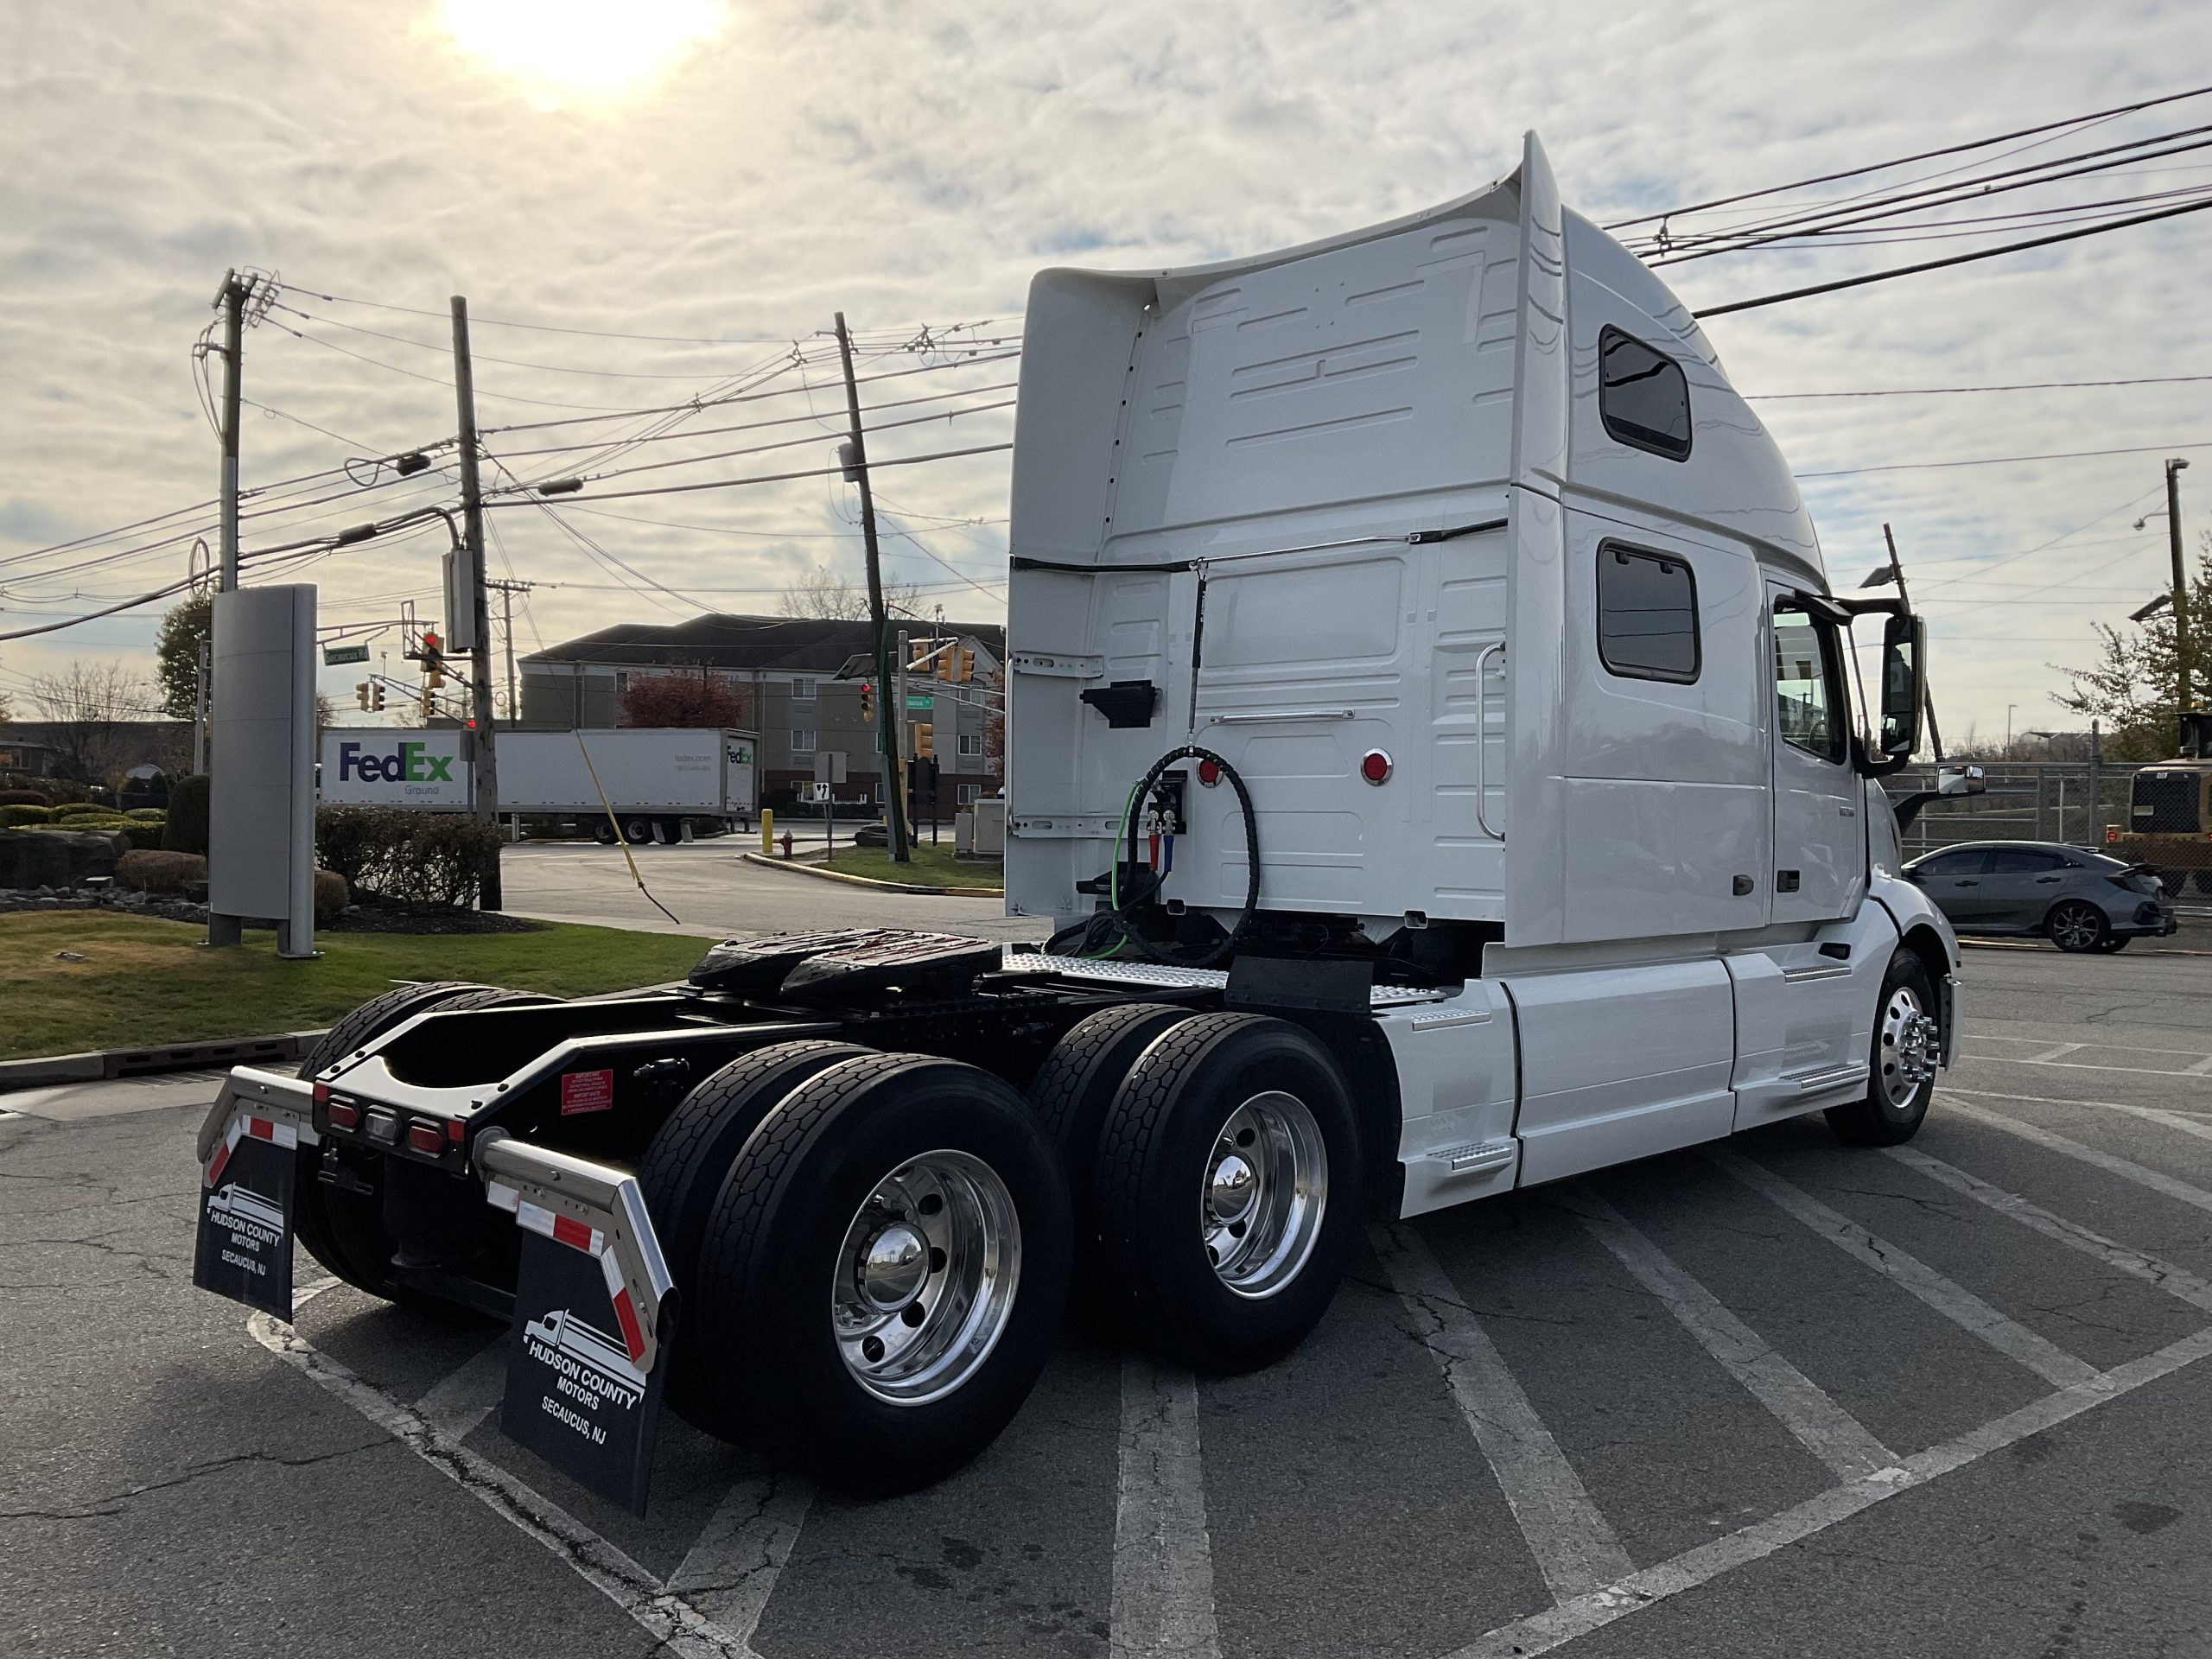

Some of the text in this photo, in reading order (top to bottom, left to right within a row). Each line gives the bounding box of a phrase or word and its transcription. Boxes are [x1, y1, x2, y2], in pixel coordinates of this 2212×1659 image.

[340, 742, 454, 782] FedEx
[727, 745, 752, 765] FedEx
[404, 785, 440, 795] Ground
[211, 1211, 280, 1247] HUDSON COUNTY
[231, 1232, 260, 1252] MOTORS
[221, 1249, 266, 1275] SECAUCUS, NJ
[529, 1341, 637, 1410] HUDSON COUNTY
[556, 1376, 600, 1410] MOTORS
[542, 1395, 607, 1445] SECAUCUS, NJ
